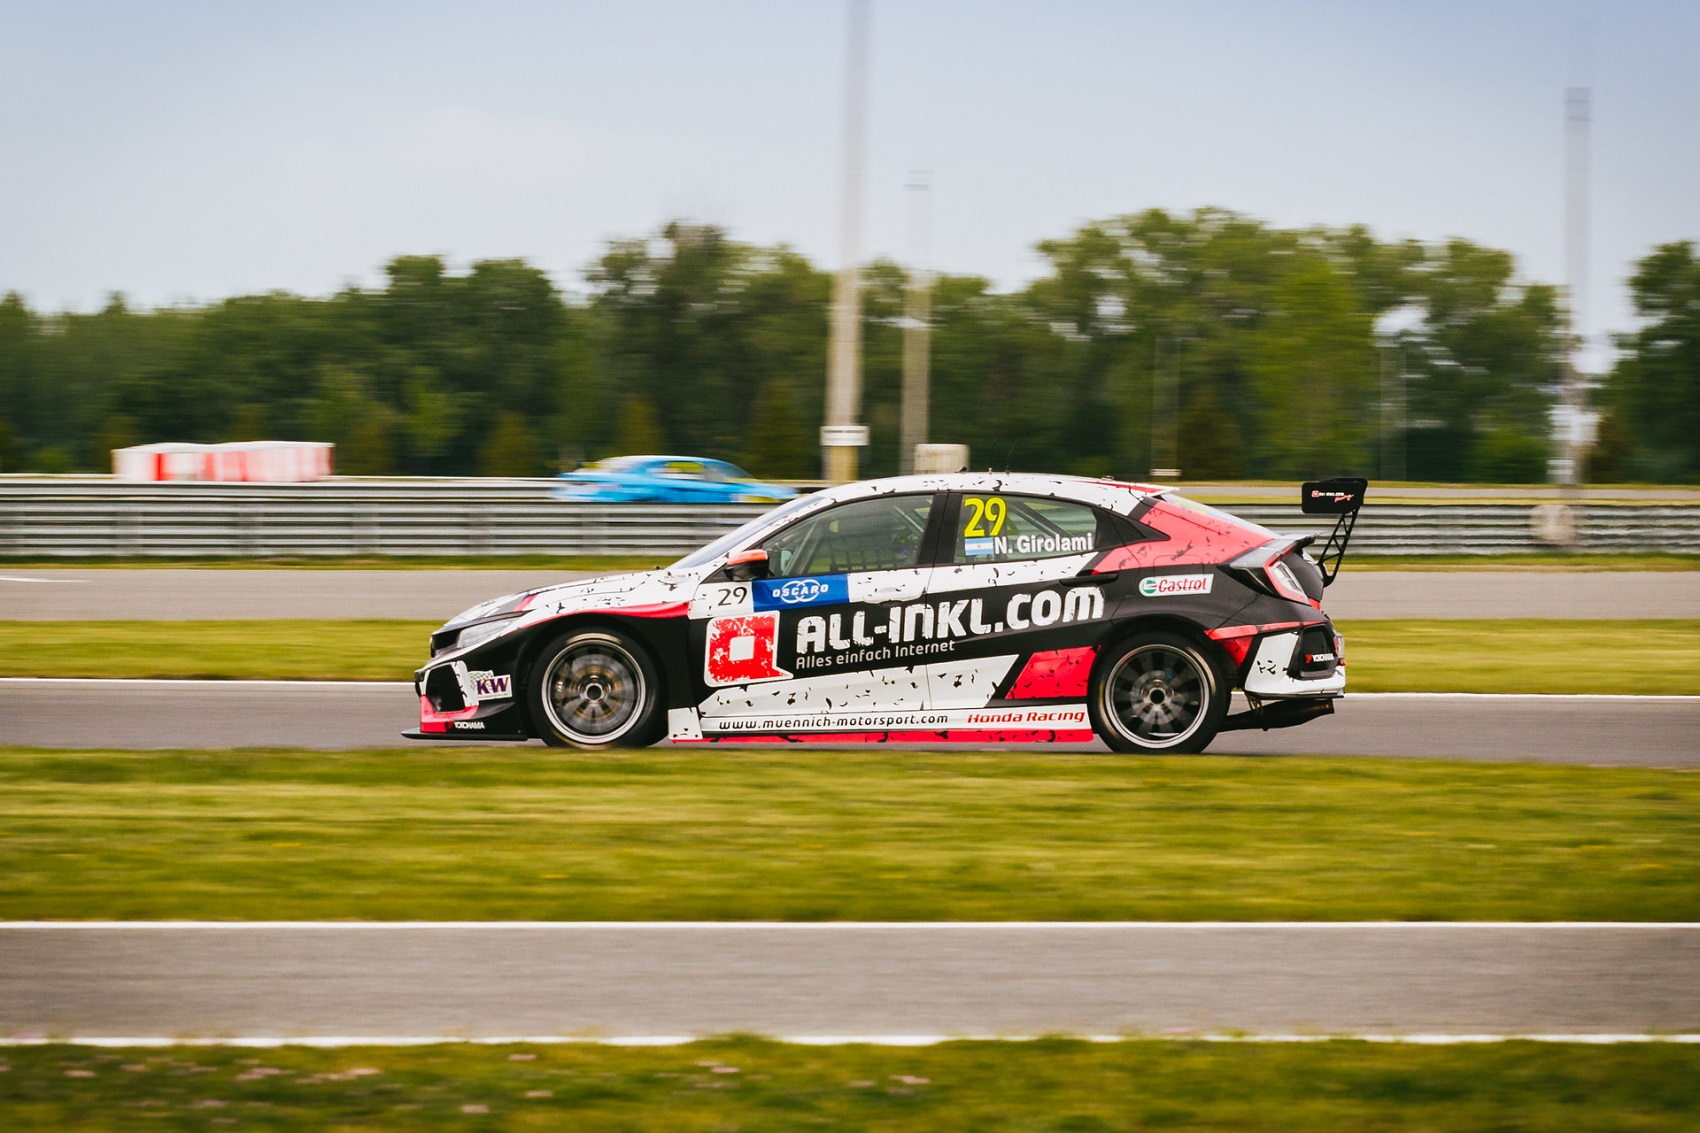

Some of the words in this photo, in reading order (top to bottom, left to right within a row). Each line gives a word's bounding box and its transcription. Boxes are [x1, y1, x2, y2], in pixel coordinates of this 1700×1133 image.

[964, 497, 1006, 538] 29
[994, 536, 1013, 555] N.
[1016, 532, 1094, 553] Girolami
[772, 583, 829, 598] OSCARO
[1158, 577, 1207, 593] Castrol
[717, 586, 748, 607] 29
[796, 655, 832, 670] Alles
[836, 646, 891, 665] einfach
[895, 639, 955, 658] Internet
[476, 676, 509, 695] KW
[454, 721, 485, 730] YOKOHAMA
[719, 714, 948, 730] www.muennich-motorsport.com
[967, 711, 1023, 724] Honda
[1026, 711, 1086, 723] Racing
